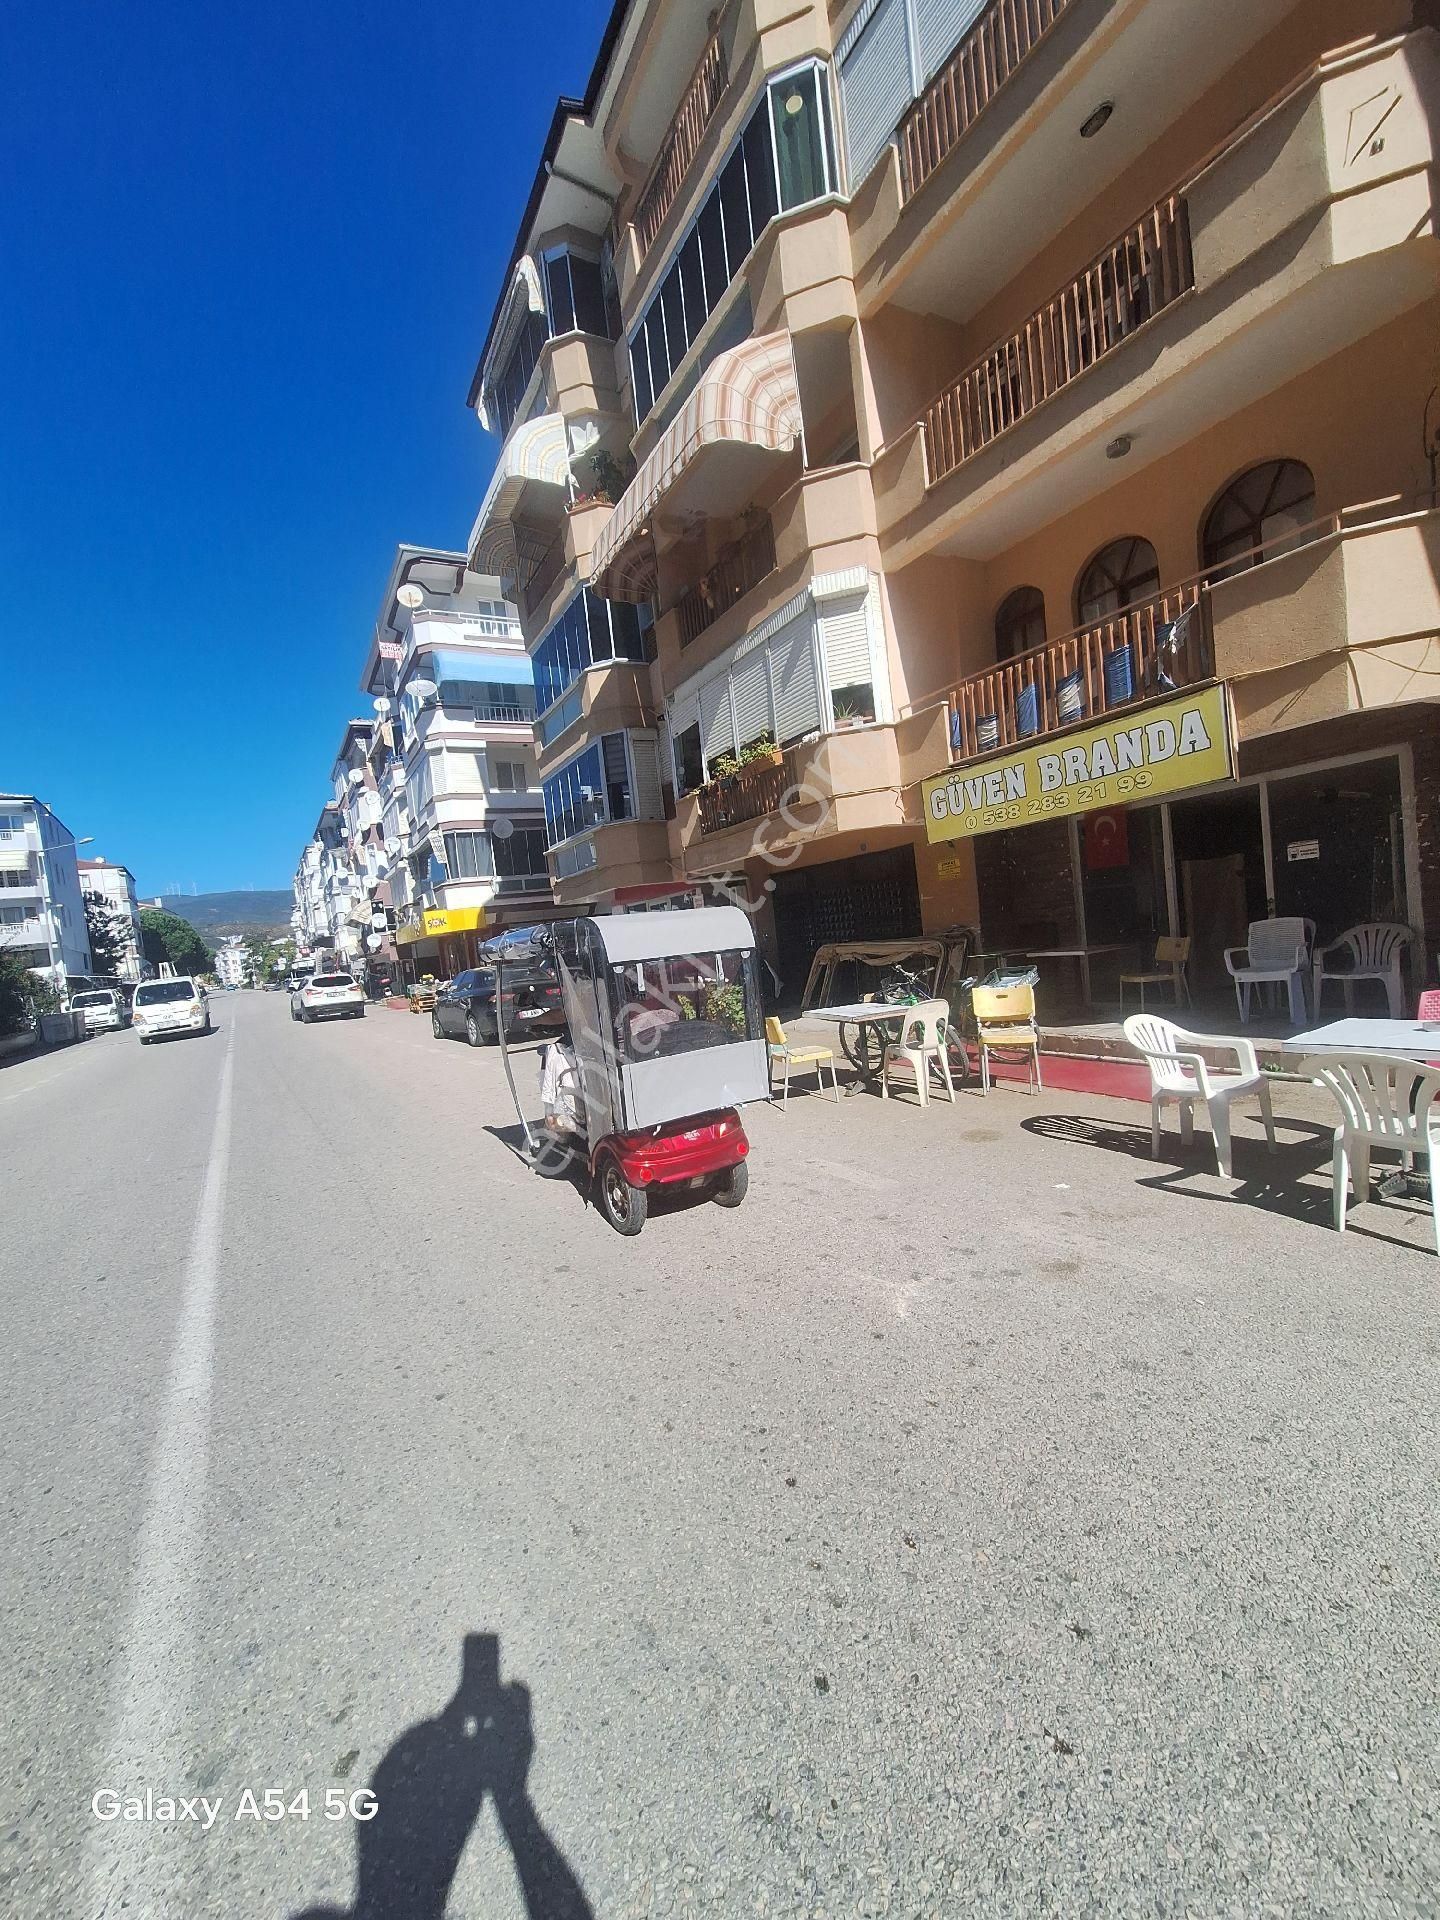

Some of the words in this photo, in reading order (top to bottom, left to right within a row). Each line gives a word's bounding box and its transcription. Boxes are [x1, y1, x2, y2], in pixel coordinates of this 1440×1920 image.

[930, 763, 1027, 820] GÜVEN
[1037, 708, 1212, 792] BRANDA
[965, 815, 978, 829] 0
[983, 804, 1021, 826] 538
[1027, 791, 1070, 816] 283
[1077, 781, 1107, 804] 21
[1116, 770, 1154, 793] 99
